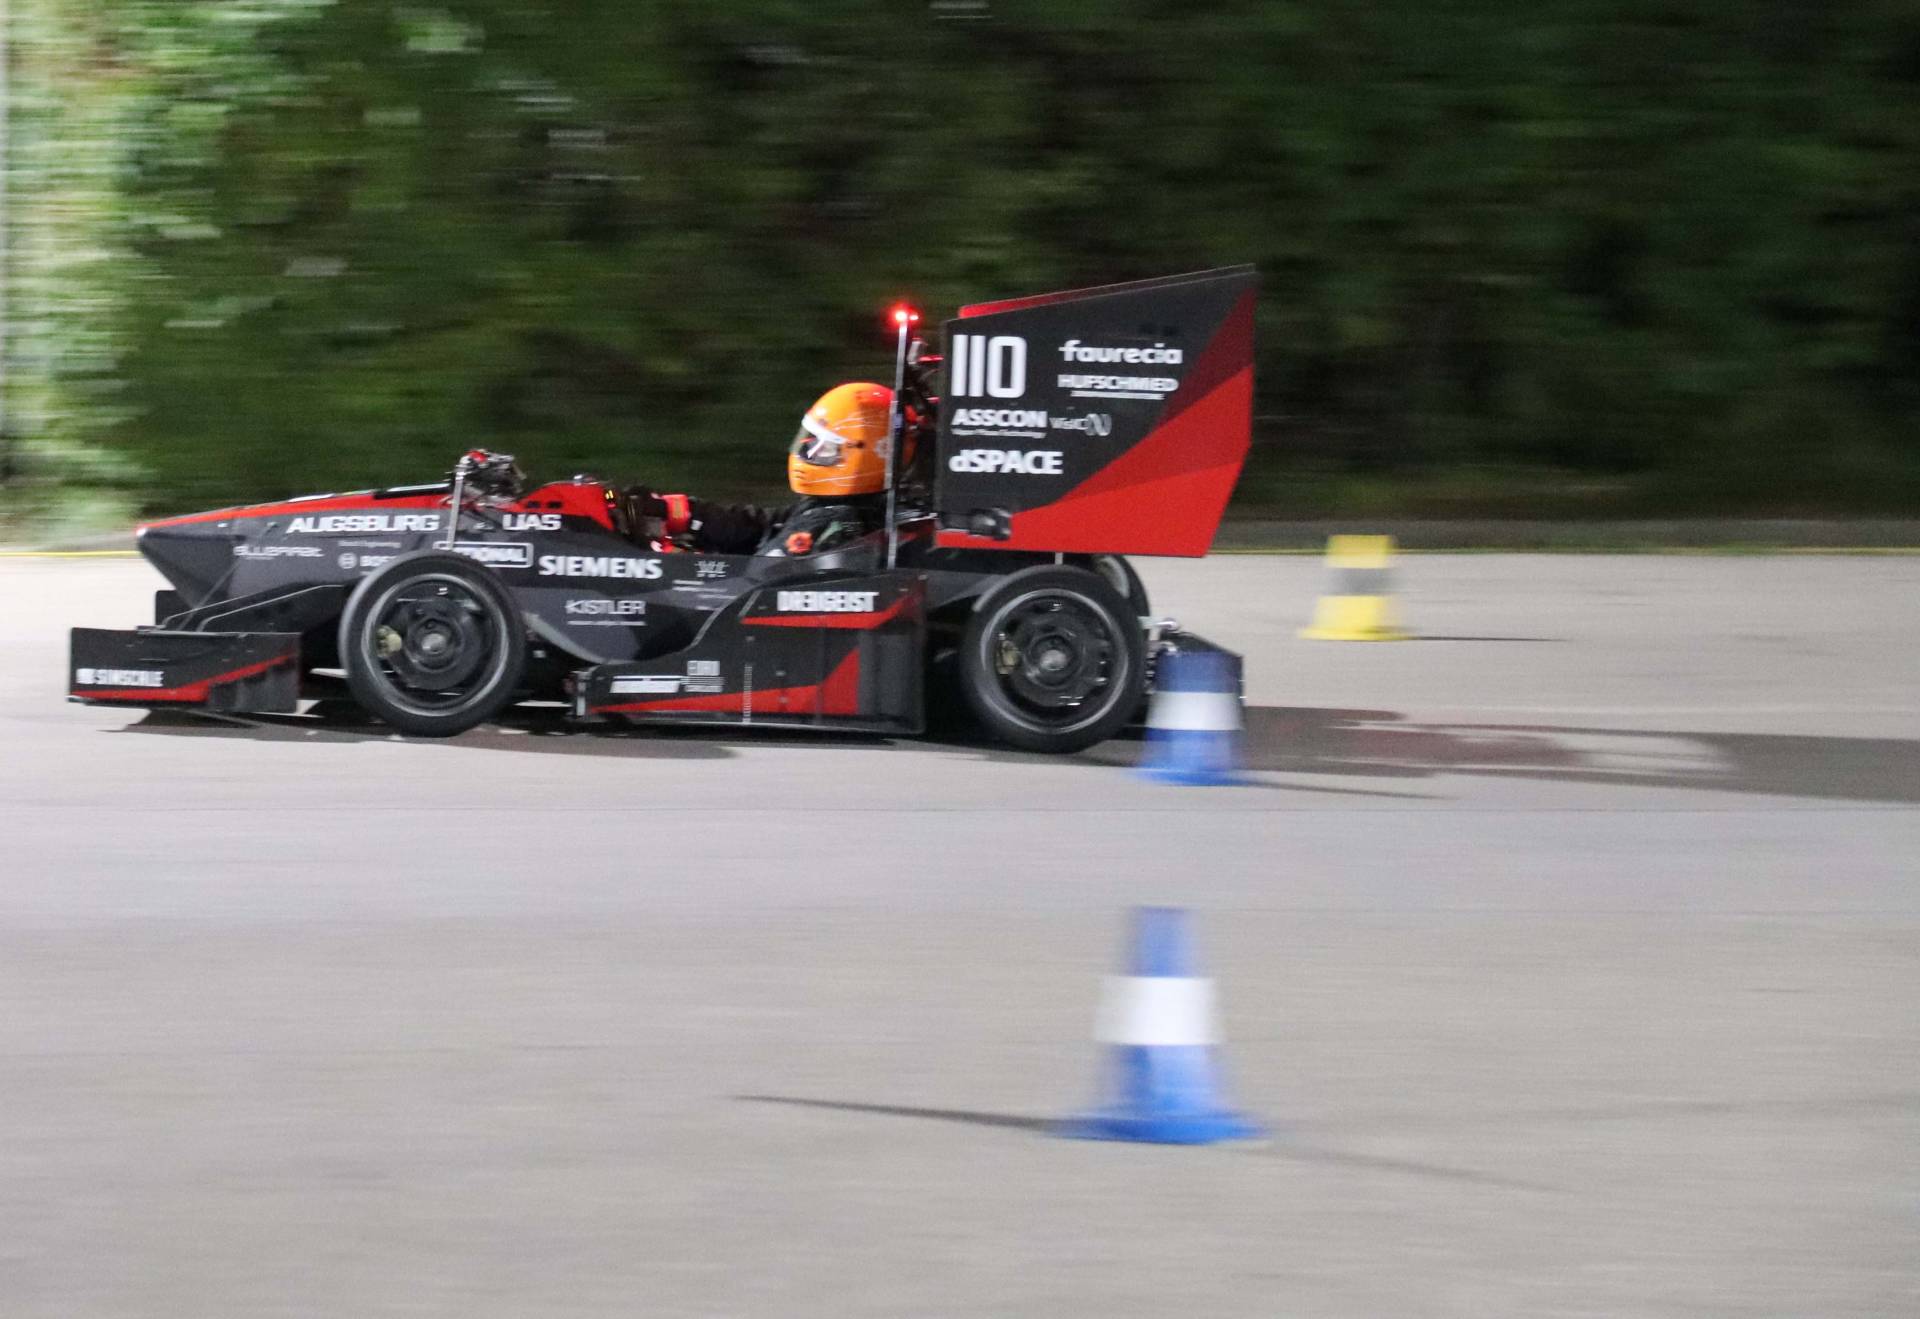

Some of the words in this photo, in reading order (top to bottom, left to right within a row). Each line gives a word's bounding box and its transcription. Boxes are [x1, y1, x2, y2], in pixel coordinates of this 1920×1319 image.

[1058, 339, 1184, 364] faurecia
[951, 334, 1027, 399] 110
[951, 408, 1048, 428] ASSCON
[948, 449, 1064, 474] dSPACE
[286, 514, 440, 534] AUGSBURG
[502, 514, 562, 531] UAS
[538, 555, 663, 579] SIEMENS
[564, 600, 646, 615] KISTLER
